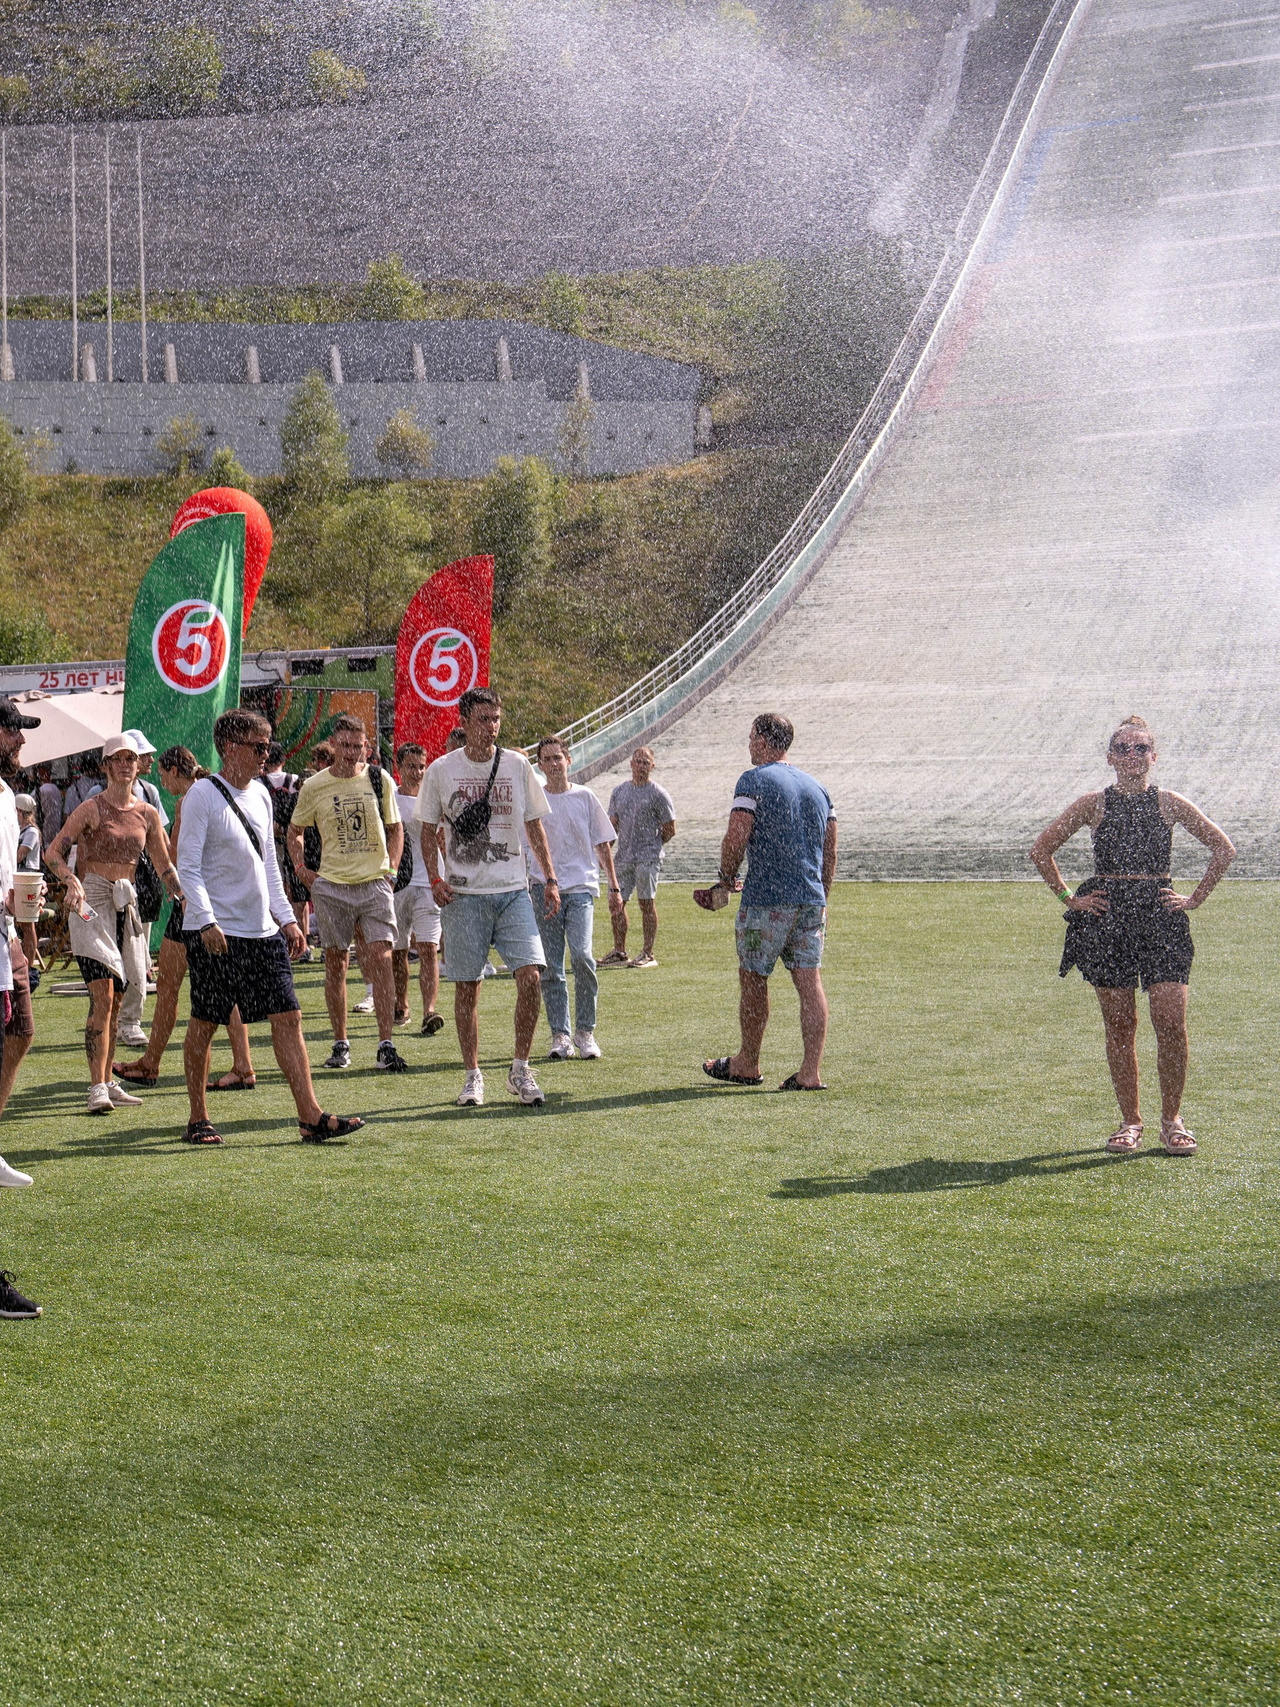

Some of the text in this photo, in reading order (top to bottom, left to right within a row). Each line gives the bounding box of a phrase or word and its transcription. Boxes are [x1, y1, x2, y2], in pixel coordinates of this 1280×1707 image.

[39, 671, 60, 688] 25
[64, 671, 100, 687] лет
[458, 785, 513, 802] SCARACE
